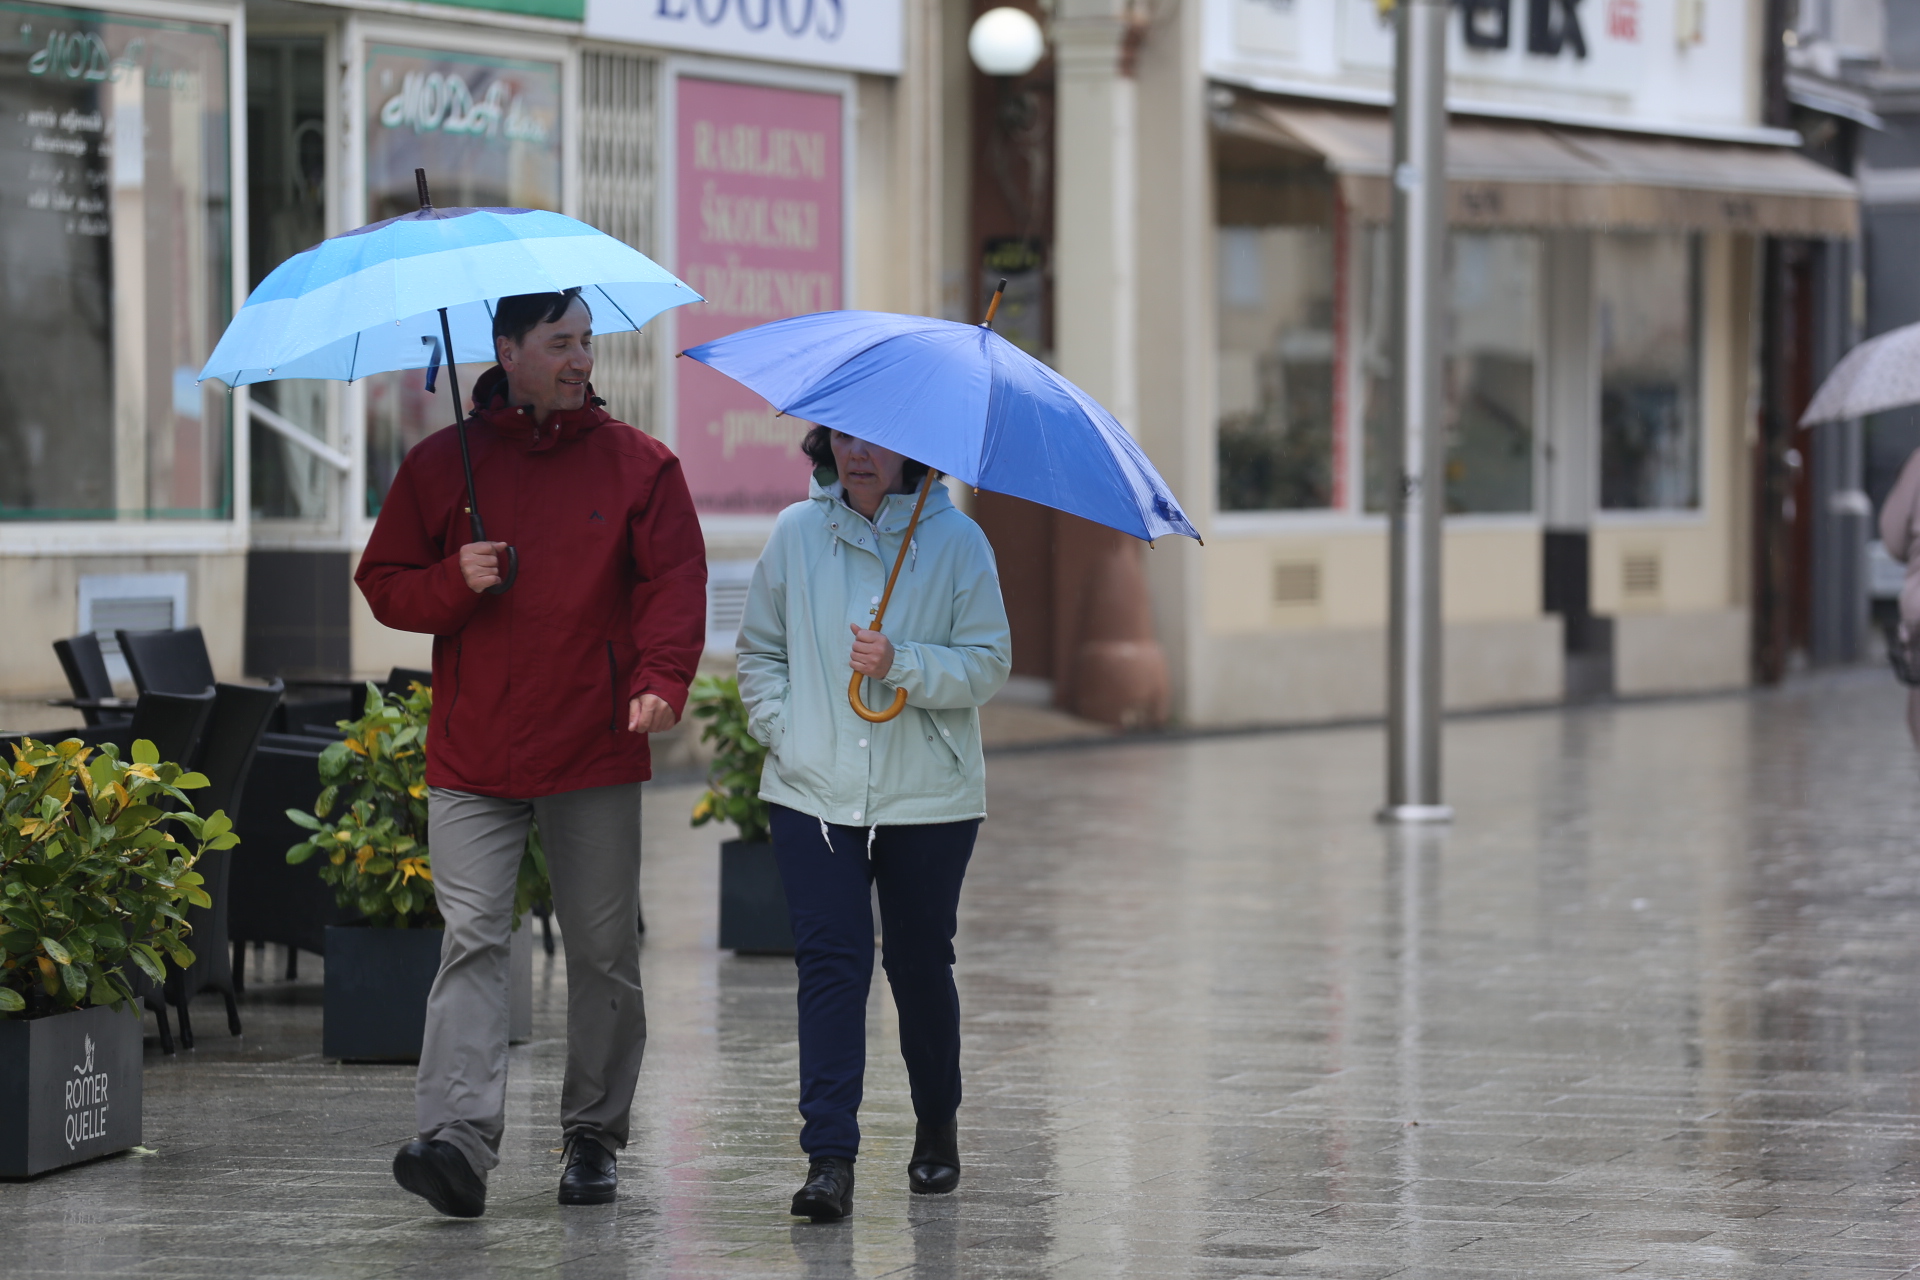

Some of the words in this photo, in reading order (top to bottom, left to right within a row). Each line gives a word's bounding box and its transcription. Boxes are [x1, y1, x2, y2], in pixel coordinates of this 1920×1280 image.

[694, 120, 826, 182] RABLJENI
[701, 180, 820, 251] ŠKOLSKI
[65, 1106, 107, 1151] QUELLE
